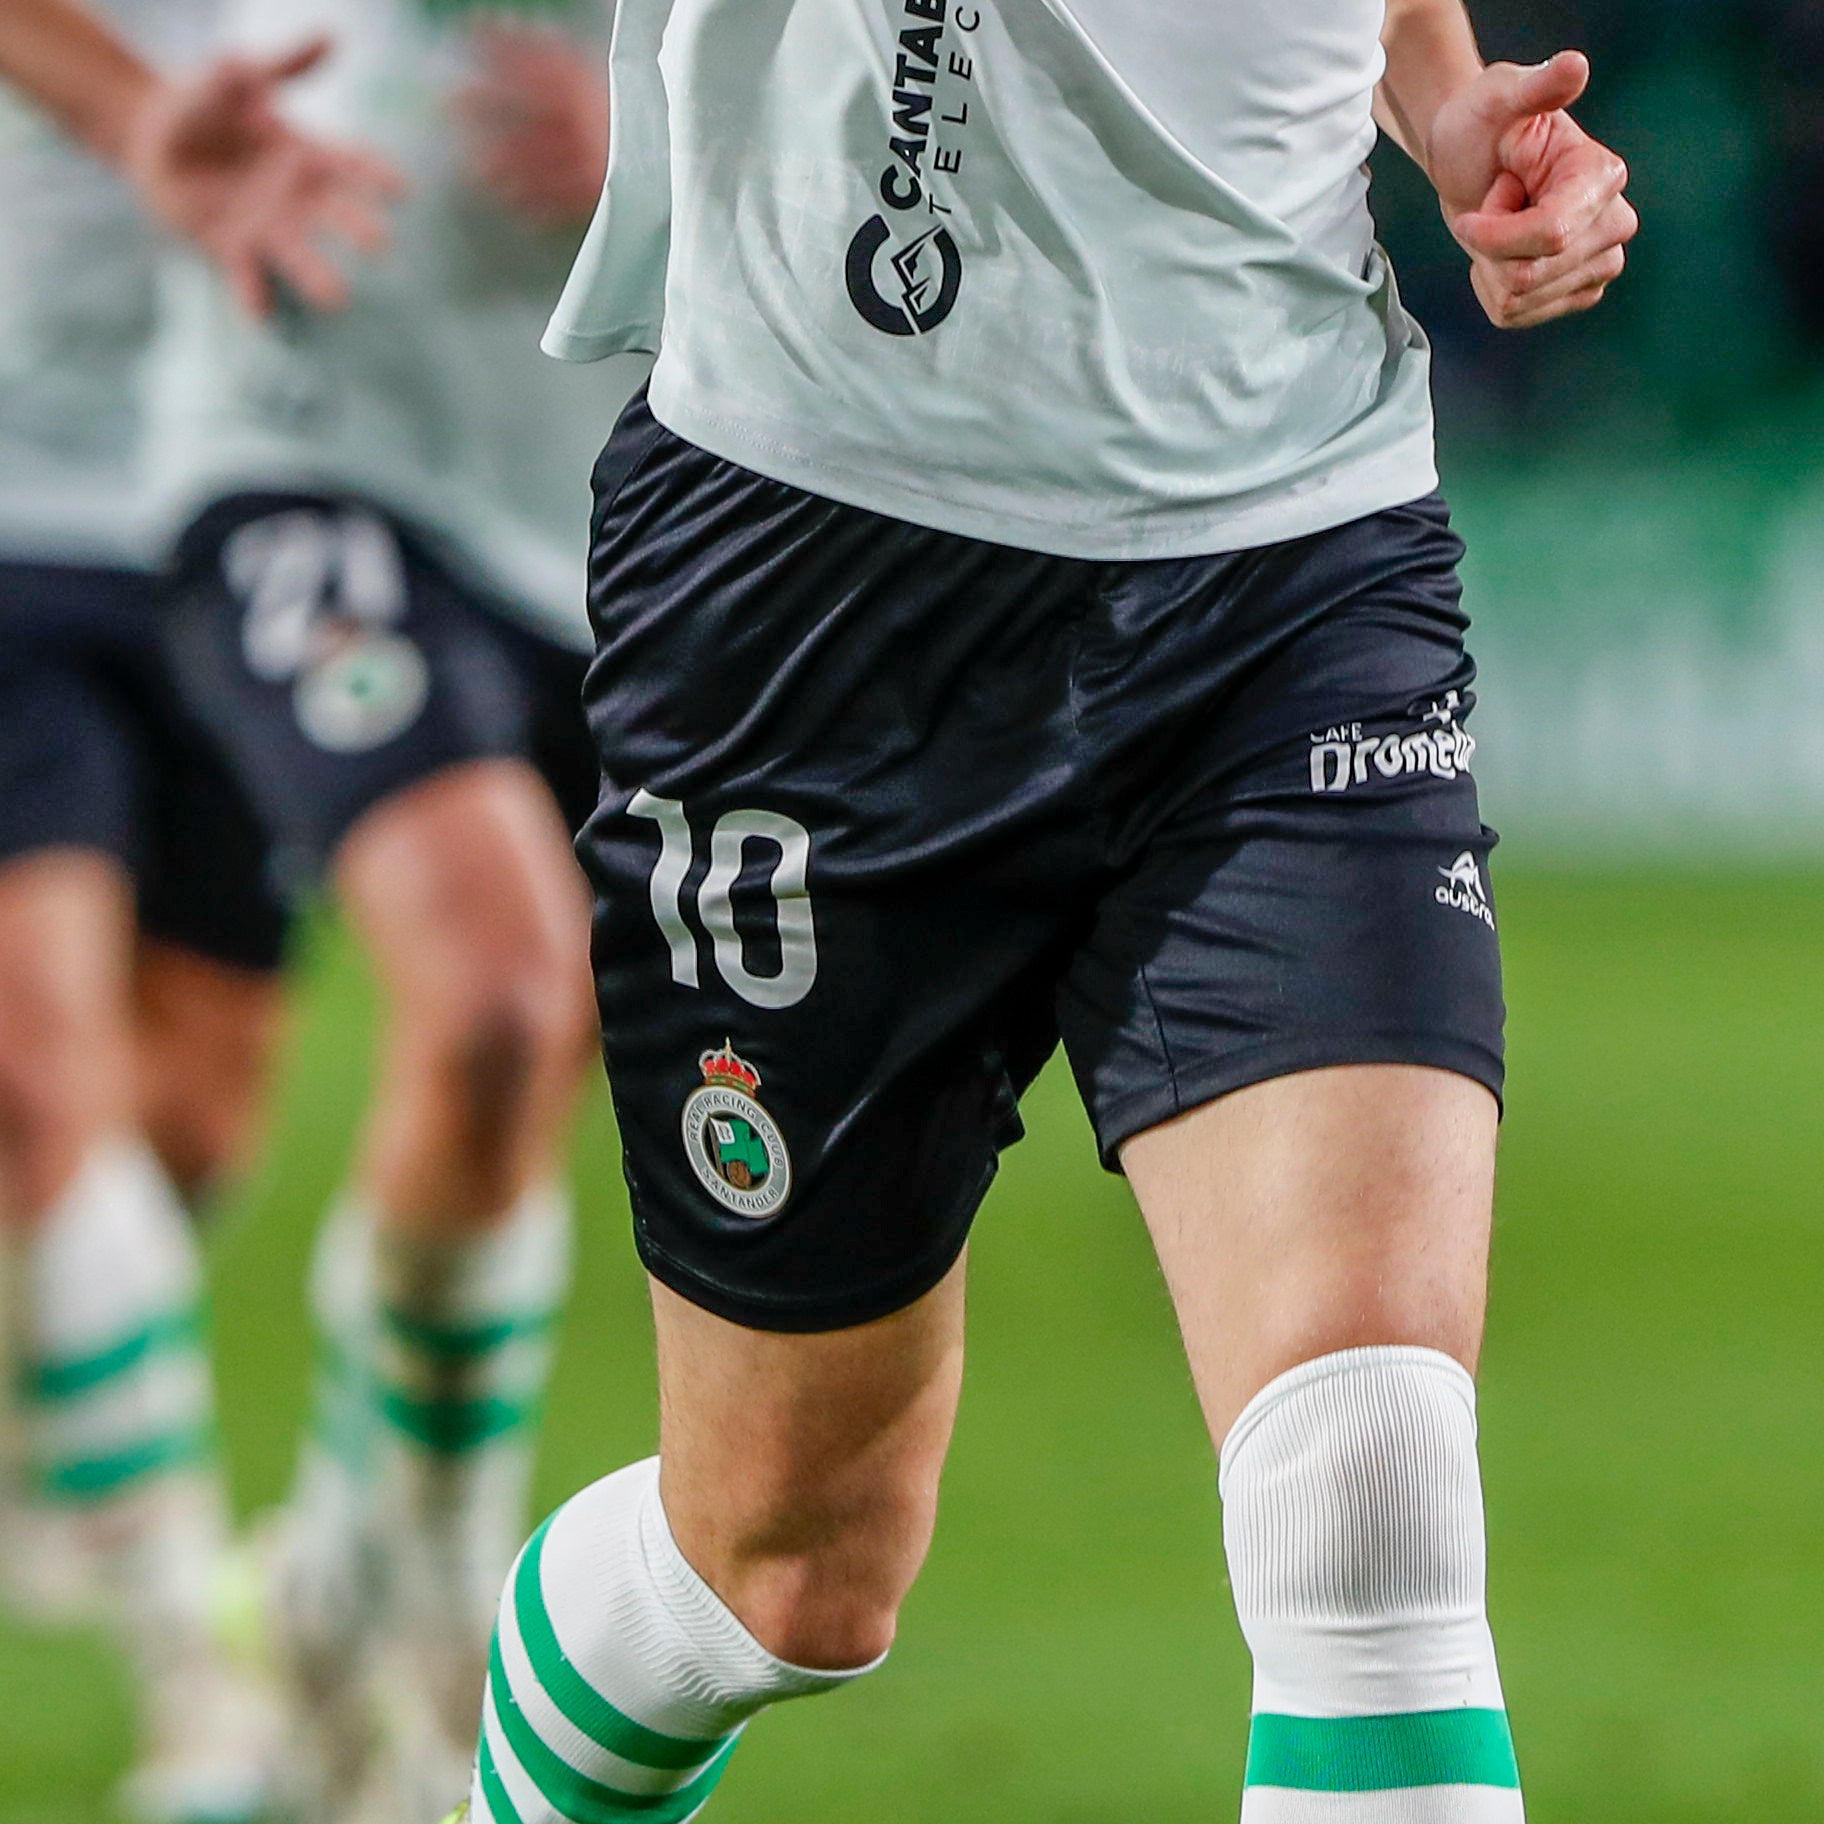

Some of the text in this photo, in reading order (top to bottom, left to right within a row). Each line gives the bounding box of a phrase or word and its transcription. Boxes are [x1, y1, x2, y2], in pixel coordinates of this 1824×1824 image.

[625, 786, 818, 1010] 10
[1434, 885, 1496, 932] austra
[689, 1093, 785, 1168] REAL RACING CLUB
[701, 1167, 780, 1209] SANTANDER
